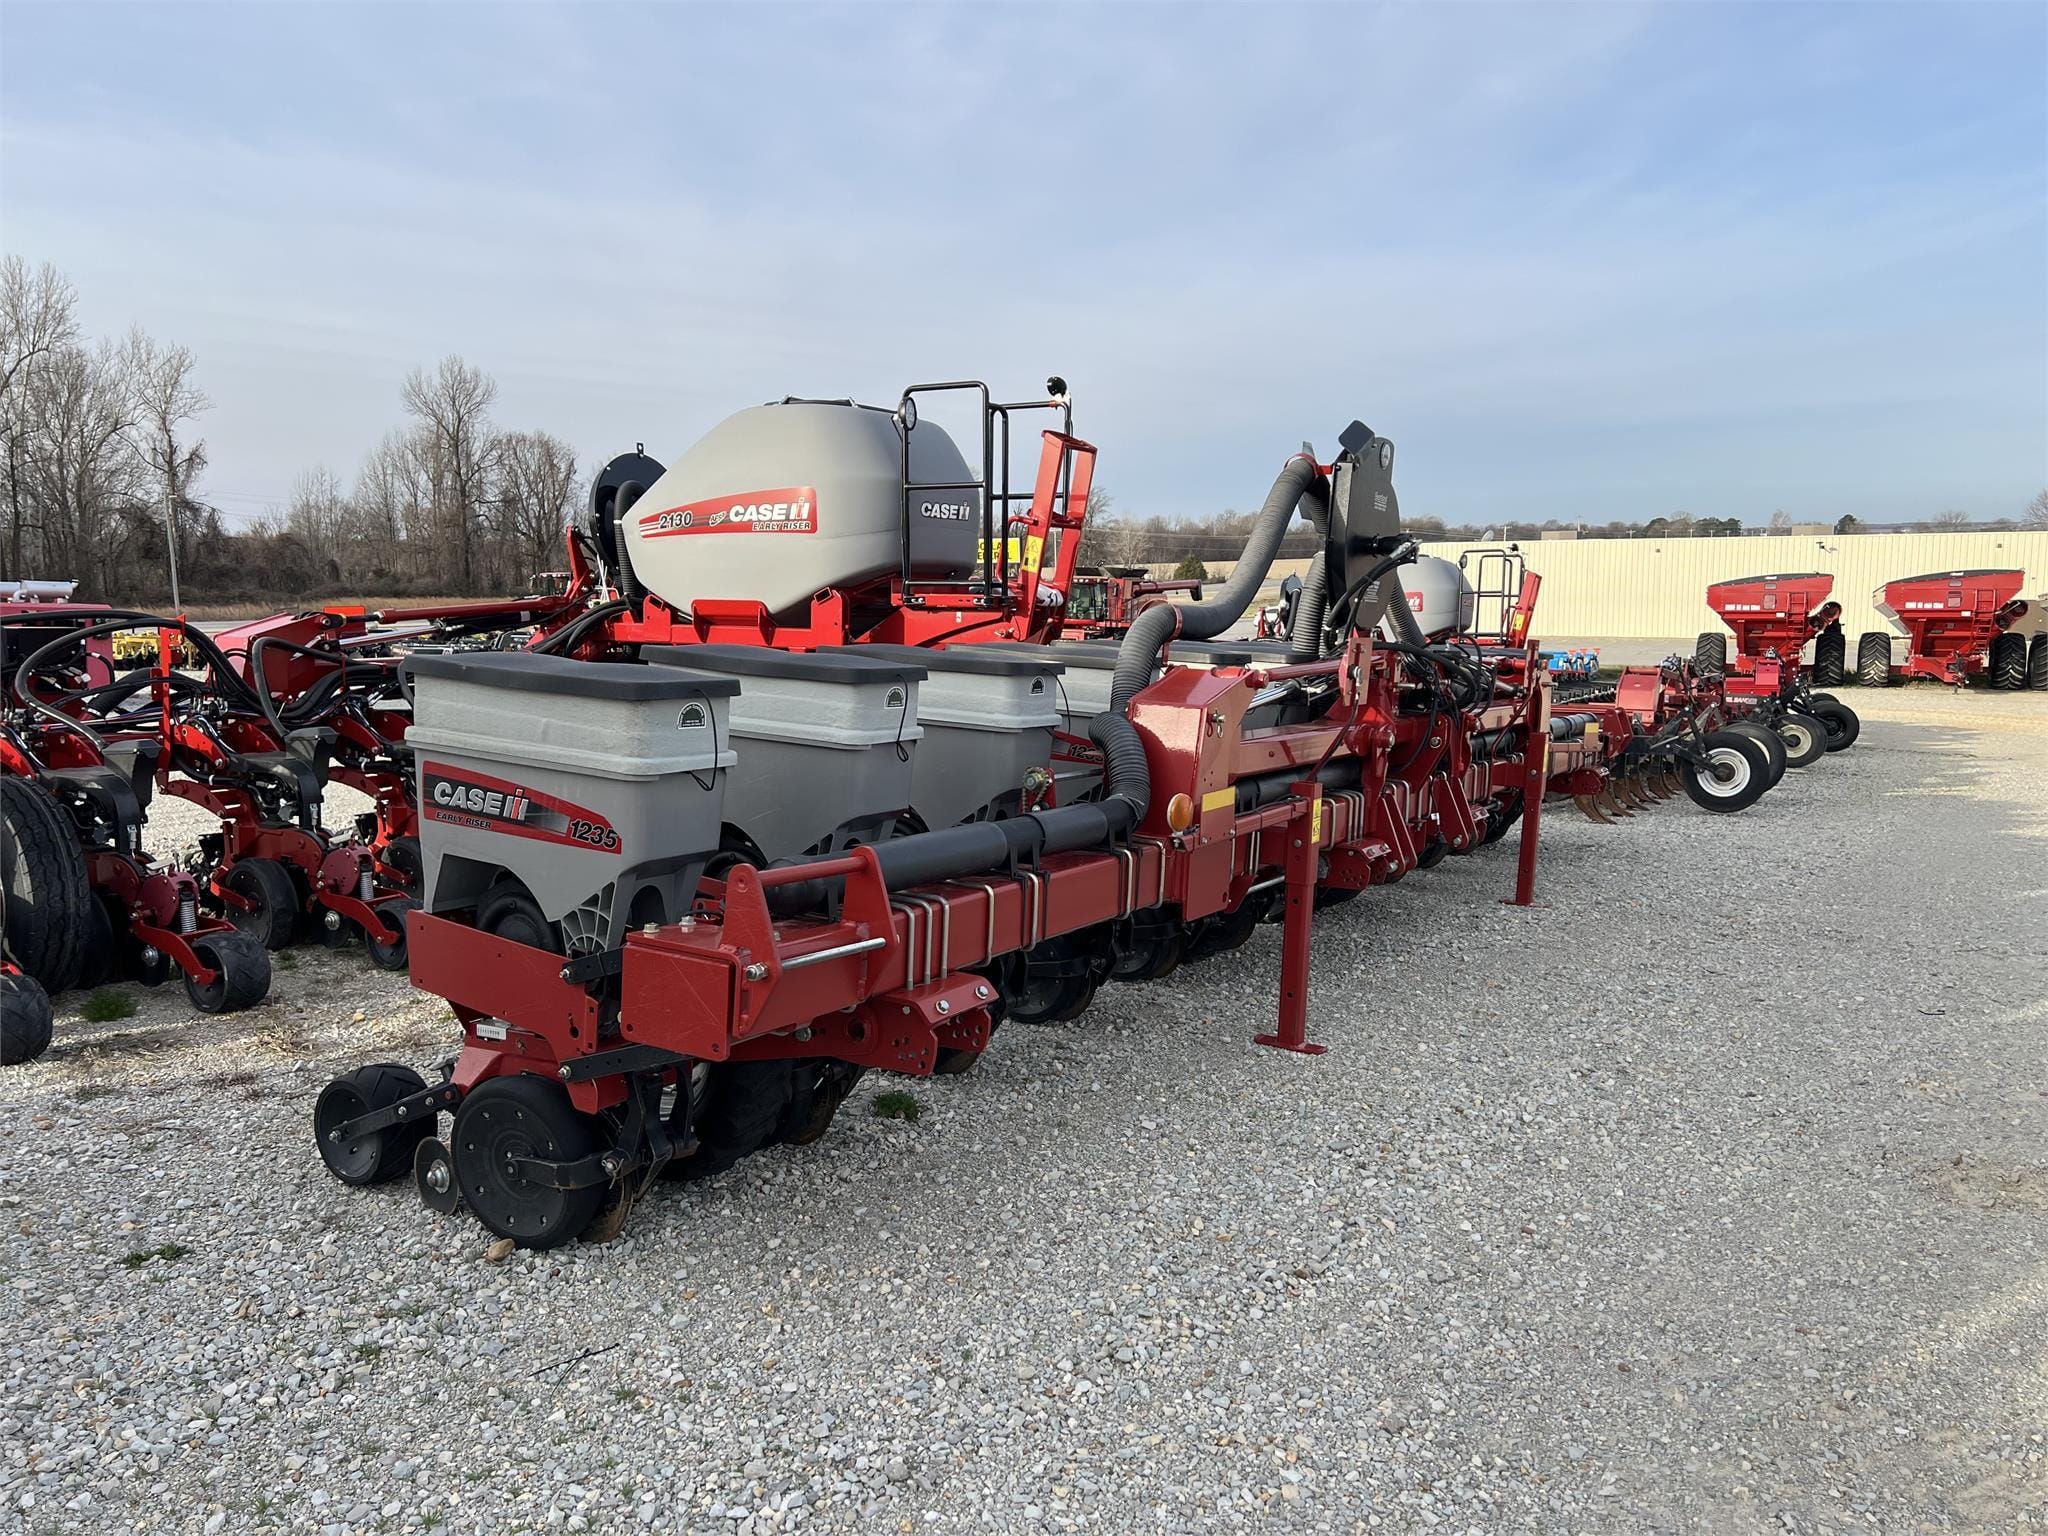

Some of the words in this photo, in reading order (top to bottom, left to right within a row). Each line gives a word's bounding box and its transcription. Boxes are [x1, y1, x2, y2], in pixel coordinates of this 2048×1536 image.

[659, 511, 693, 529] 2130
[729, 503, 787, 522] CASE
[921, 502, 958, 519] CASE
[752, 523, 780, 531] EARLY
[783, 521, 810, 530] RISER
[434, 782, 503, 815] CASE
[570, 819, 619, 849] 1235
[436, 812, 464, 824] EARLY
[465, 818, 492, 830] RISER
